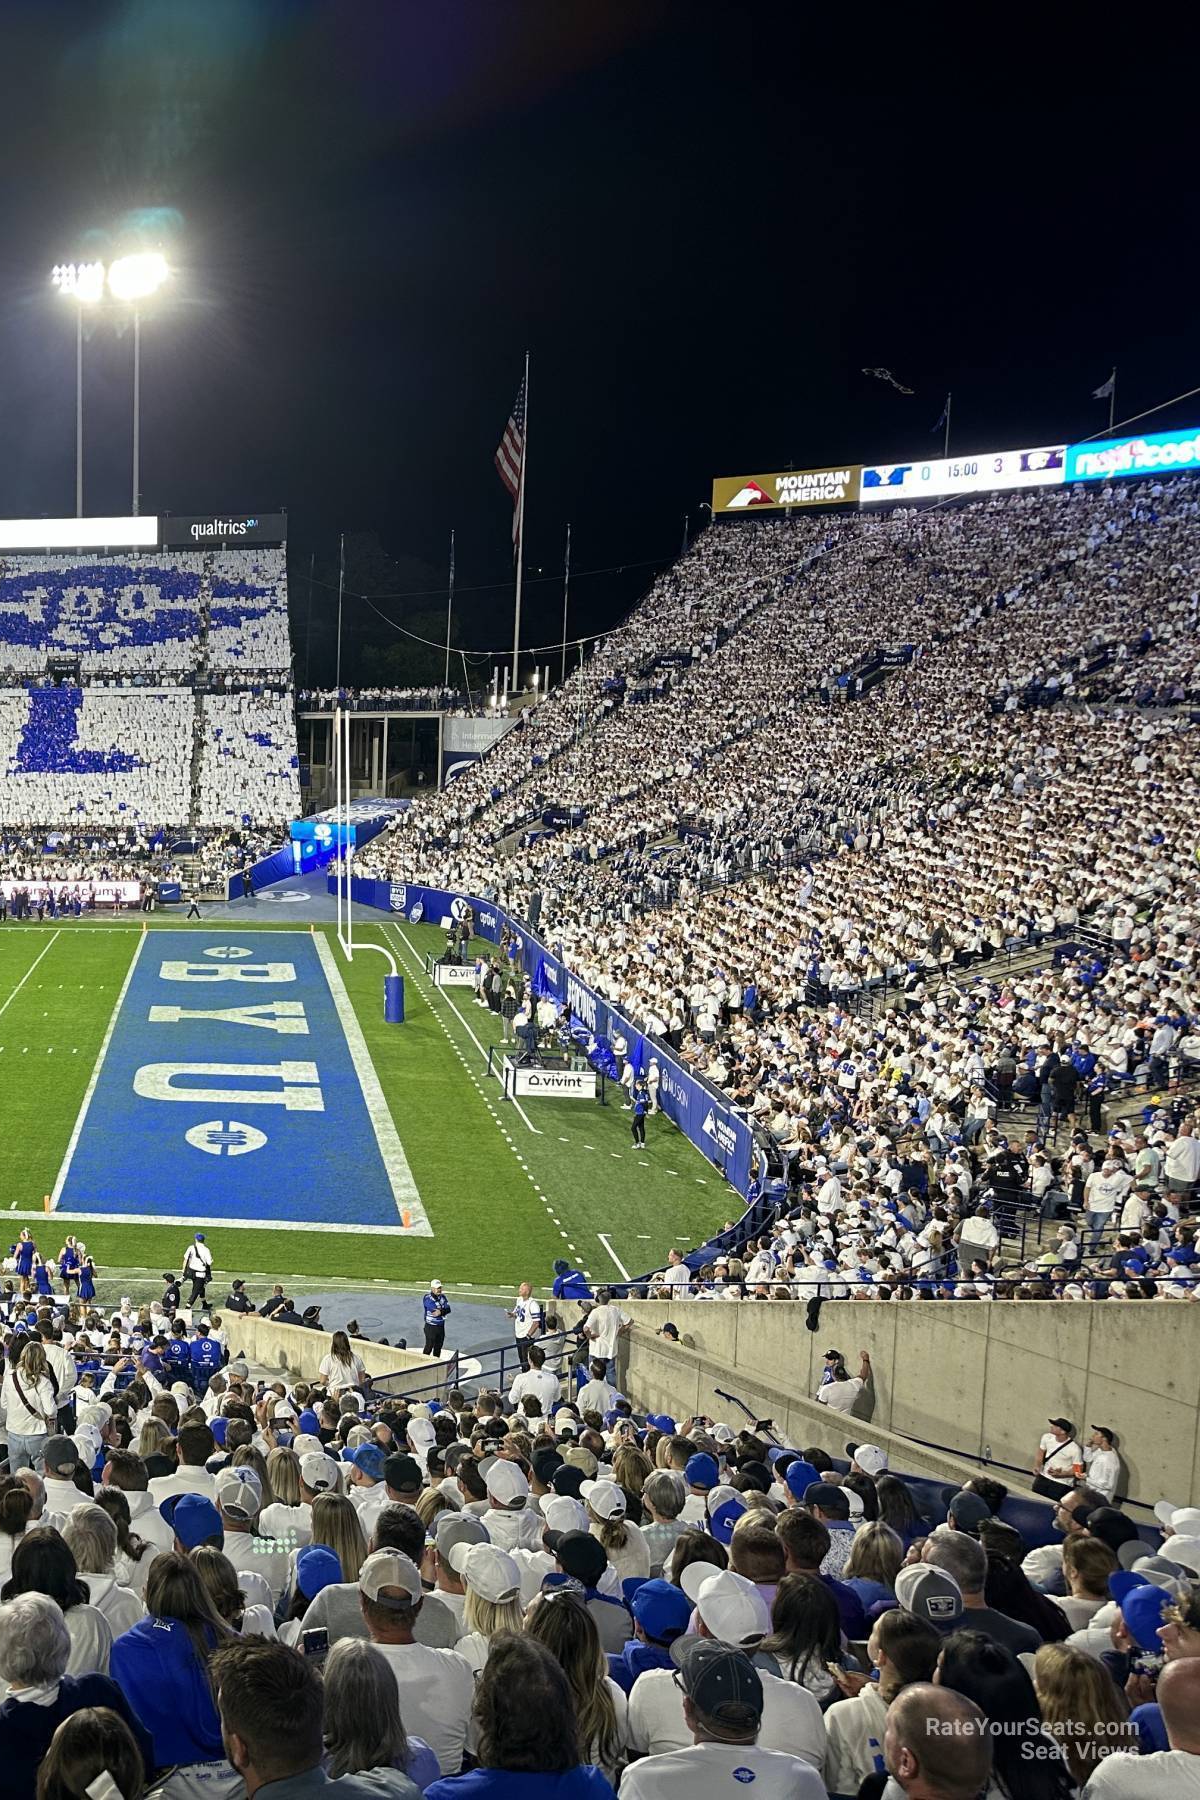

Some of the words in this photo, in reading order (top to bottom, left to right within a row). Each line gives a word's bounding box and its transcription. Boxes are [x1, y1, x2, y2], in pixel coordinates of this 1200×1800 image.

[921, 466, 931, 481] 0
[948, 462, 978, 478] 15:00
[993, 458, 1003, 474] 3
[775, 470, 851, 492] MOUNTAIN
[779, 485, 846, 504] AMERICA
[190, 519, 247, 541] qualtrics
[132, 960, 326, 1112] BYU
[842, 1062, 856, 1076] 96
[542, 1076, 582, 1088] vivint
